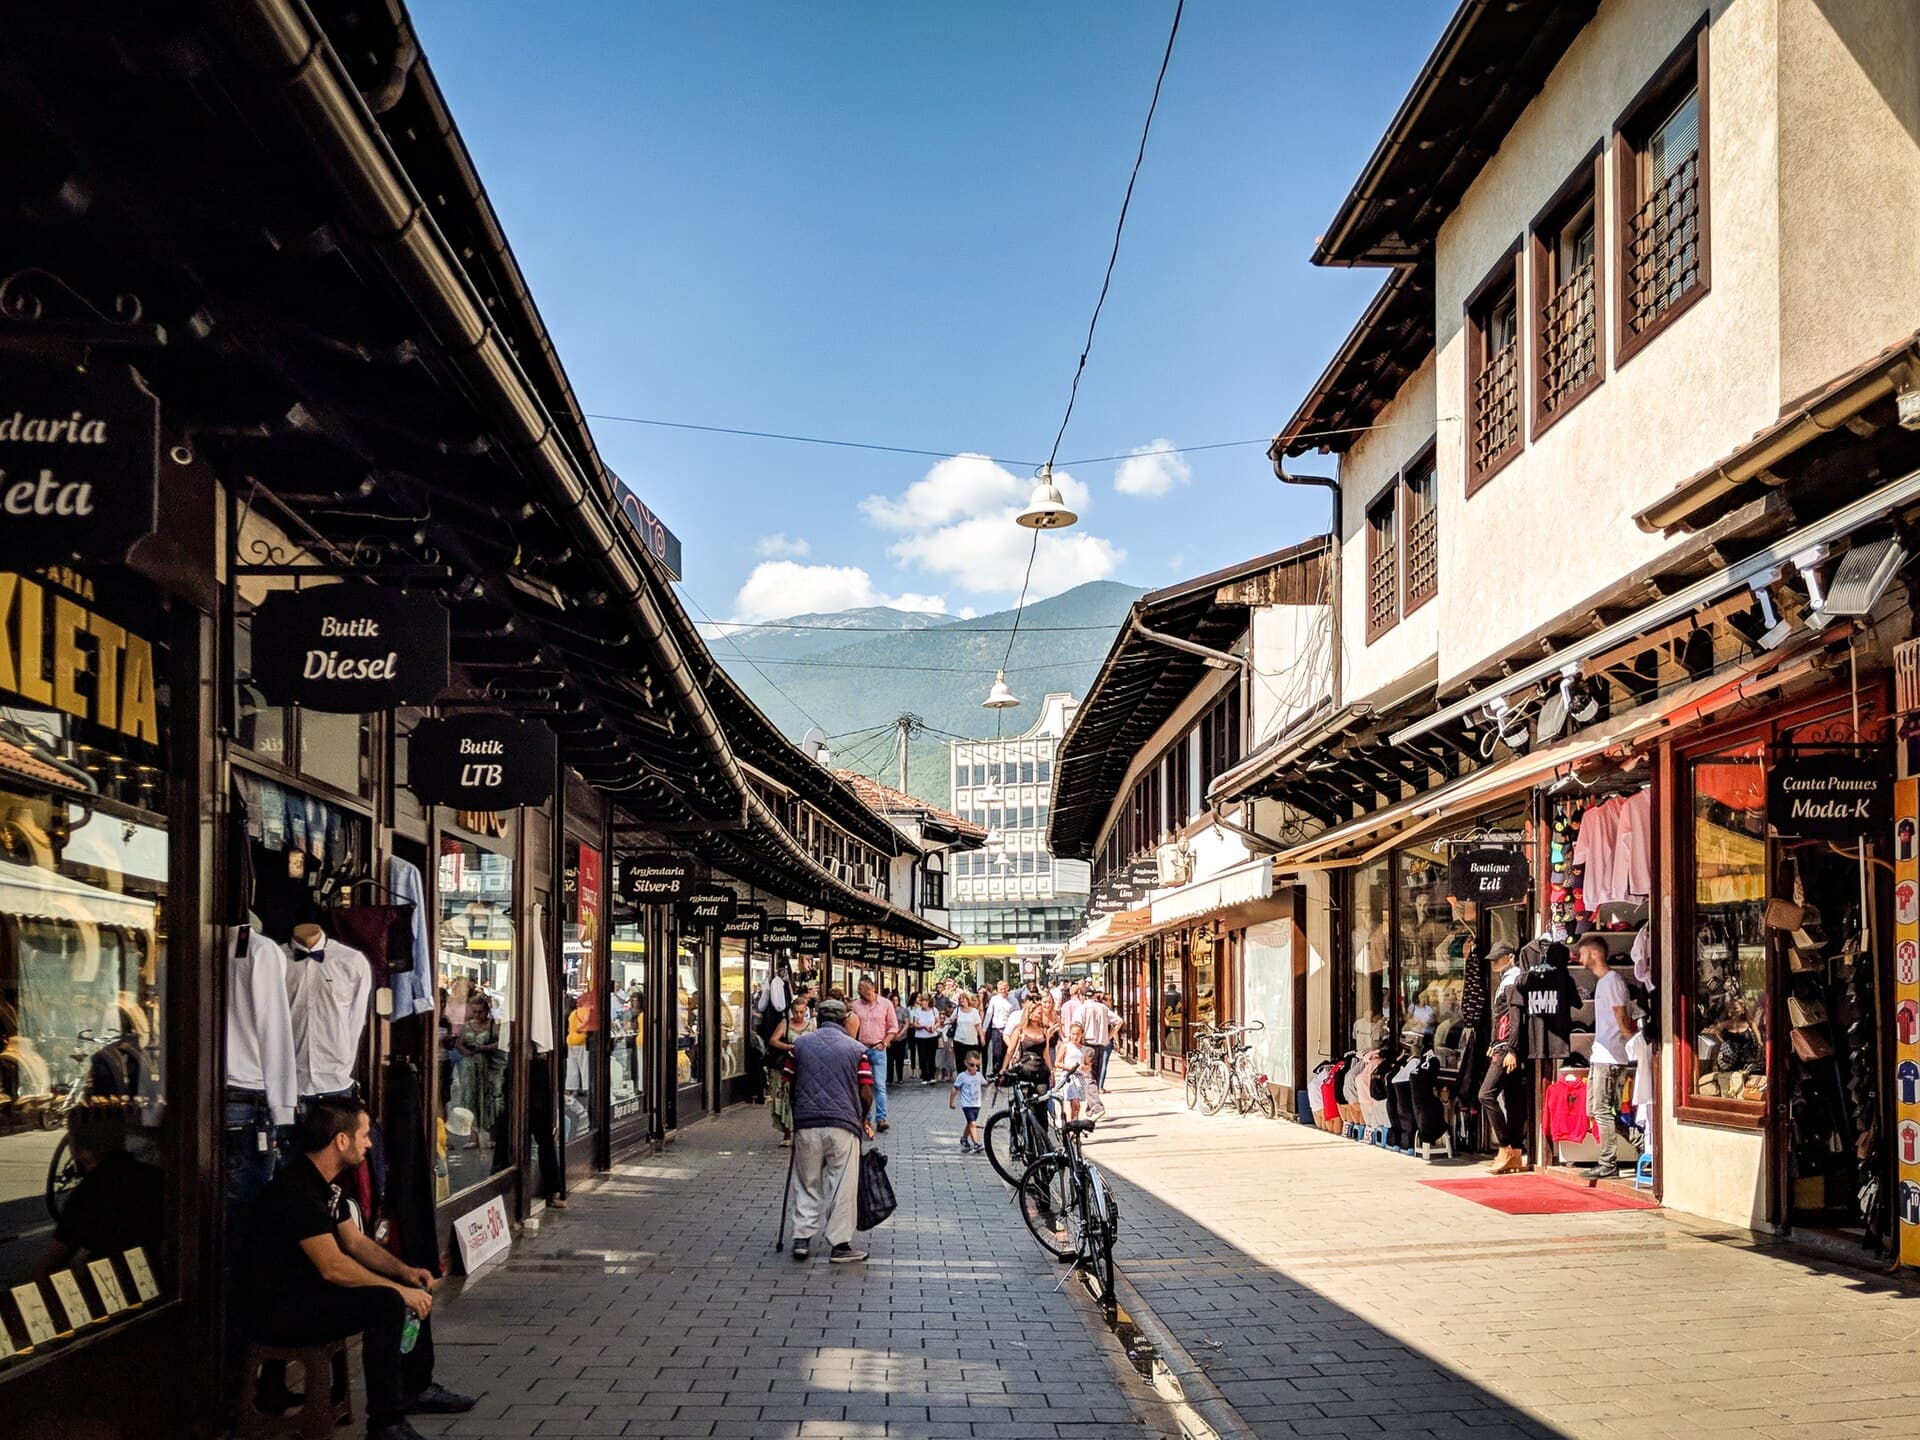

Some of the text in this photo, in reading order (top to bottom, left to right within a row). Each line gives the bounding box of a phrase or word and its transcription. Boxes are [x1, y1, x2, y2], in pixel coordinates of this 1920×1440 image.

[0, 468, 94, 516] eta
[320, 616, 379, 637] Butik
[303, 650, 398, 680] Diesel
[460, 738, 504, 754] Butik
[460, 764, 503, 787] LTB
[1827, 776, 1878, 791] Punues
[1791, 798, 1870, 819] Moda-K
[1470, 862, 1511, 874] Boutique
[633, 880, 680, 892] Silver-B
[1479, 877, 1501, 891] Edi
[689, 894, 729, 903] rgjendaria
